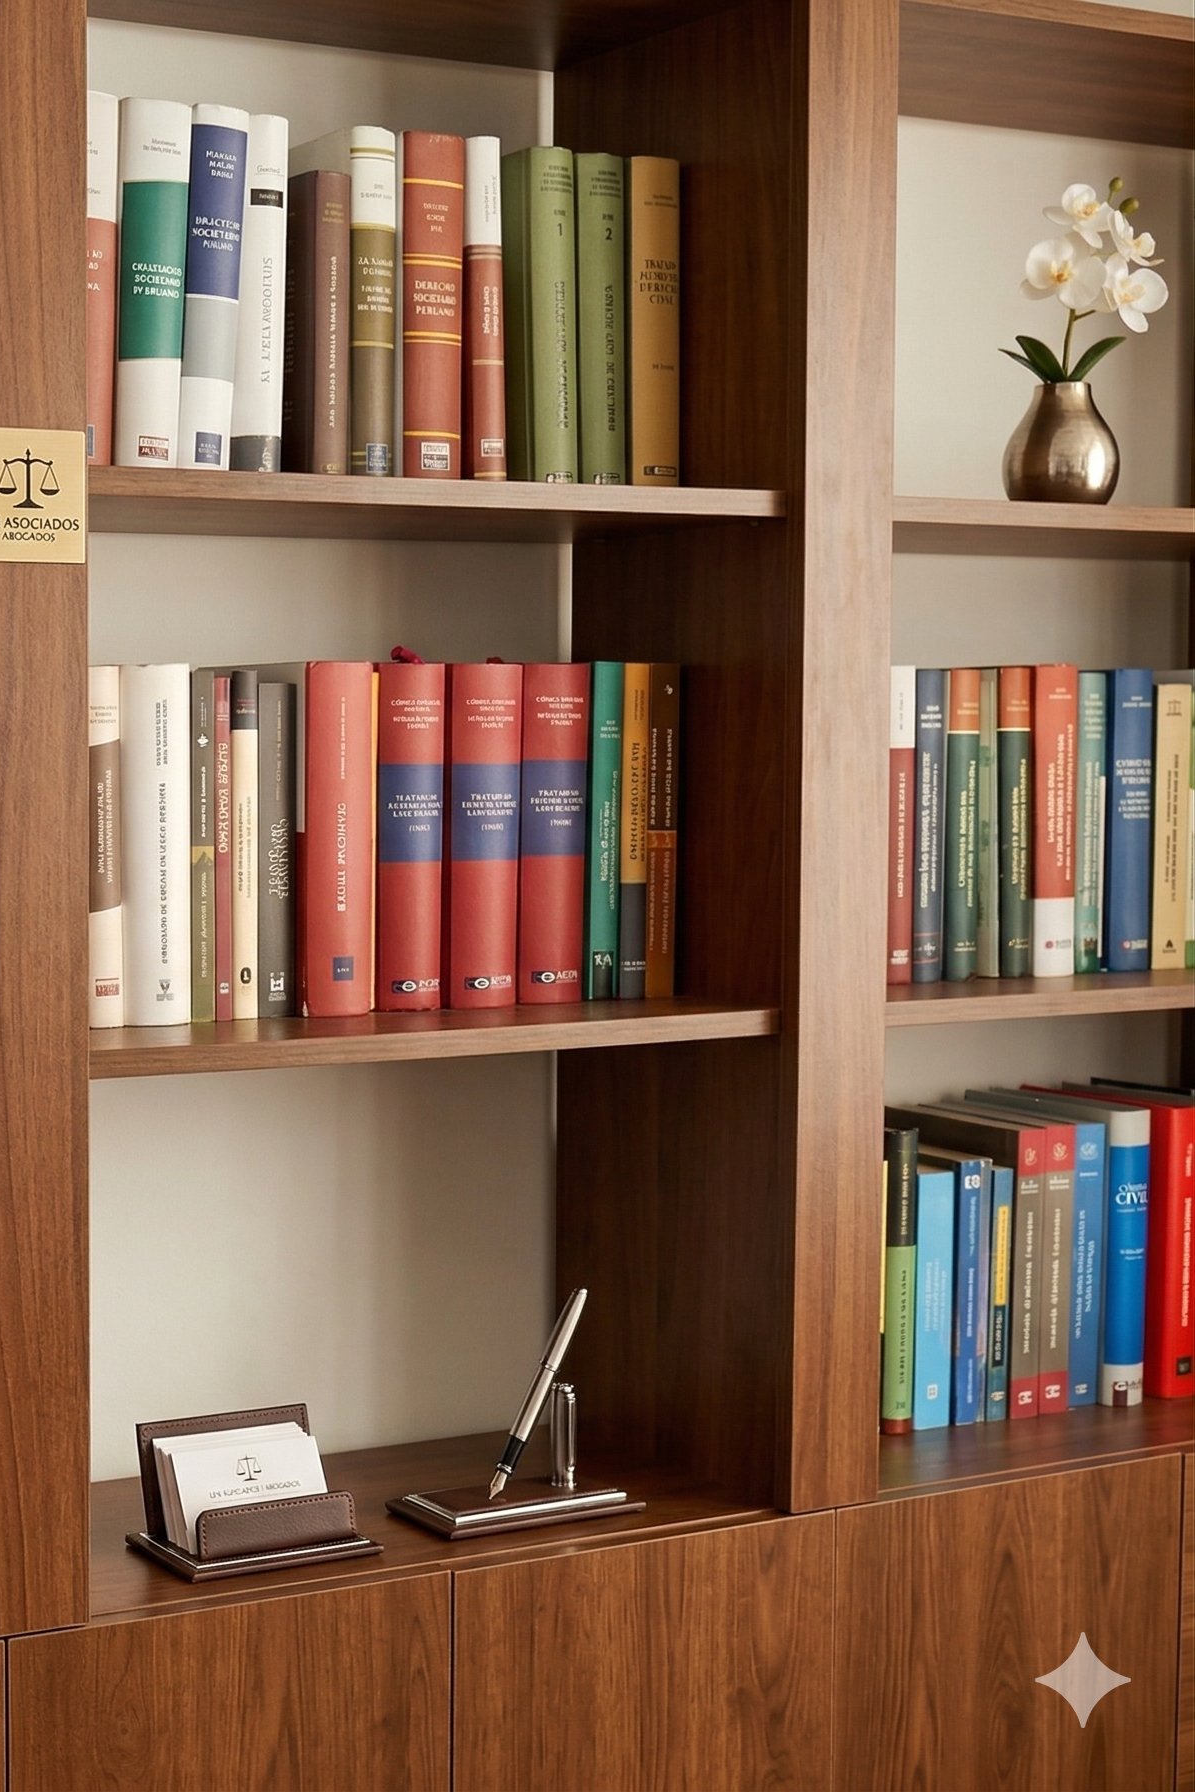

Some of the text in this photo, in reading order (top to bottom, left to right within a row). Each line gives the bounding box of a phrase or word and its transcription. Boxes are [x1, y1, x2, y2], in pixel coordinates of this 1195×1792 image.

[558, 223, 562, 236] 1
[605, 228, 612, 240] 2
[4, 517, 79, 531] ASOCIADOS
